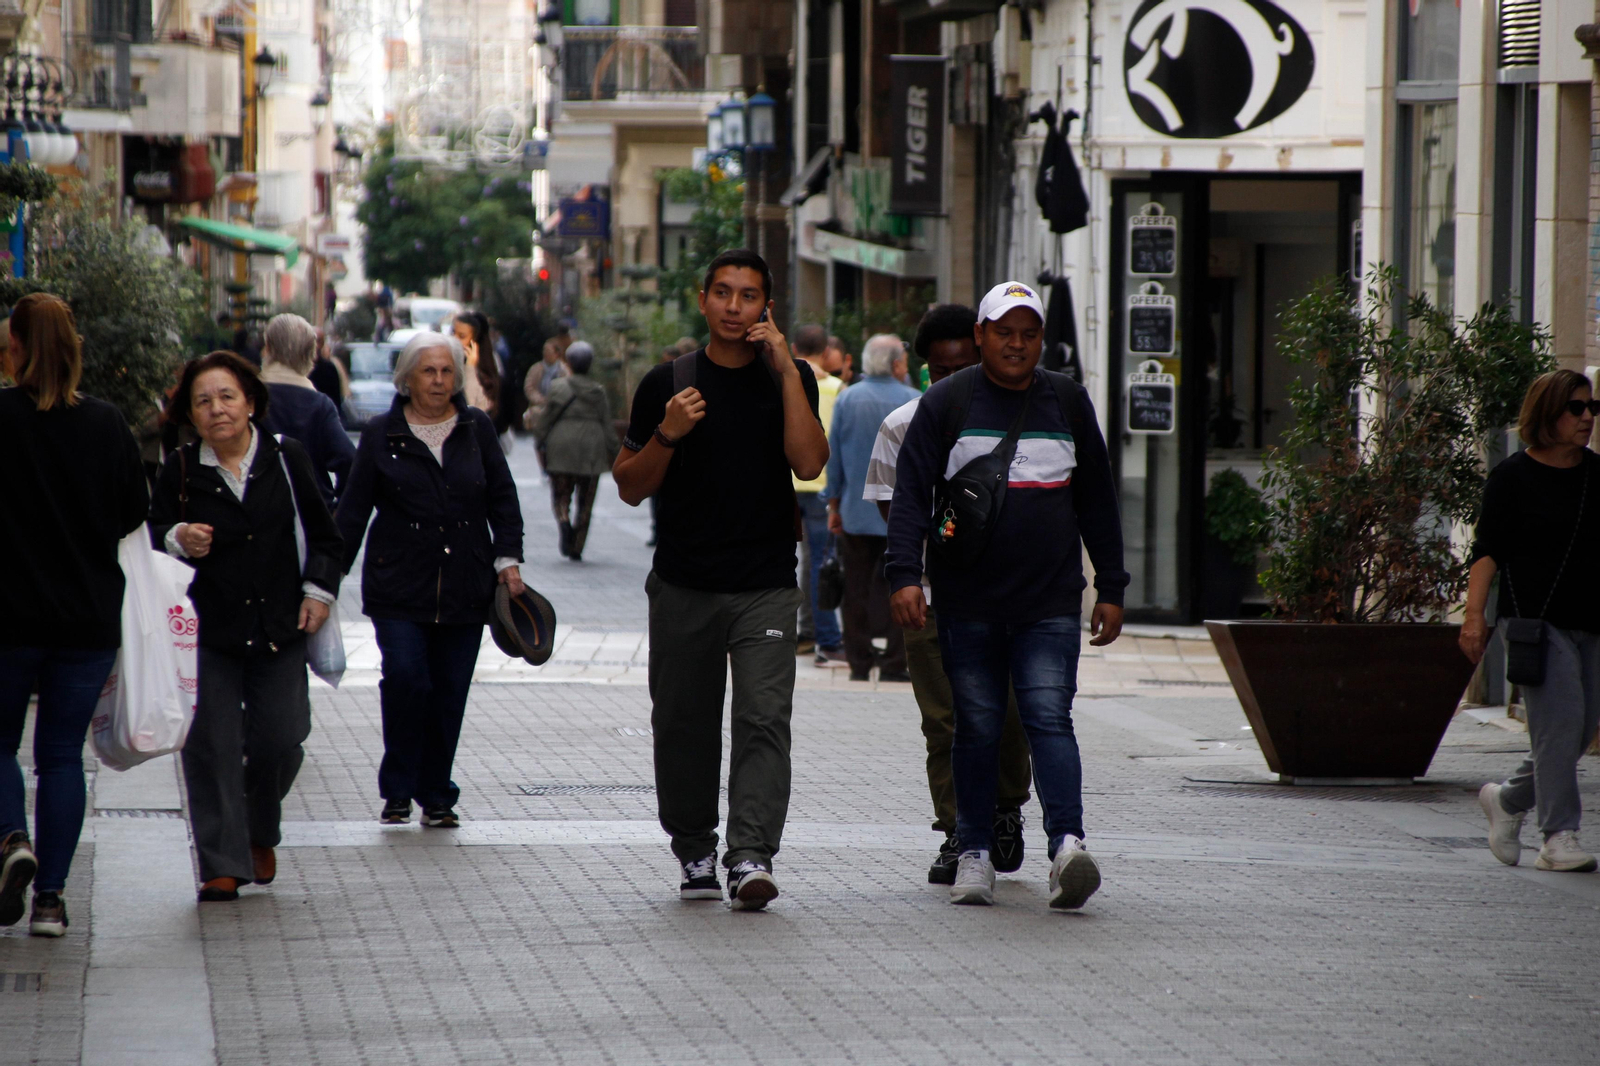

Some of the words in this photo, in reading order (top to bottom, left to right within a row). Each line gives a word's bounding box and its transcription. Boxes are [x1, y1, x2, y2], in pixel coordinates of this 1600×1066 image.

[905, 84, 928, 184] TIGER
[1133, 216, 1174, 226] OFERTA
[1131, 295, 1172, 305] OFERTA
[1131, 373, 1171, 383] OFERTA
